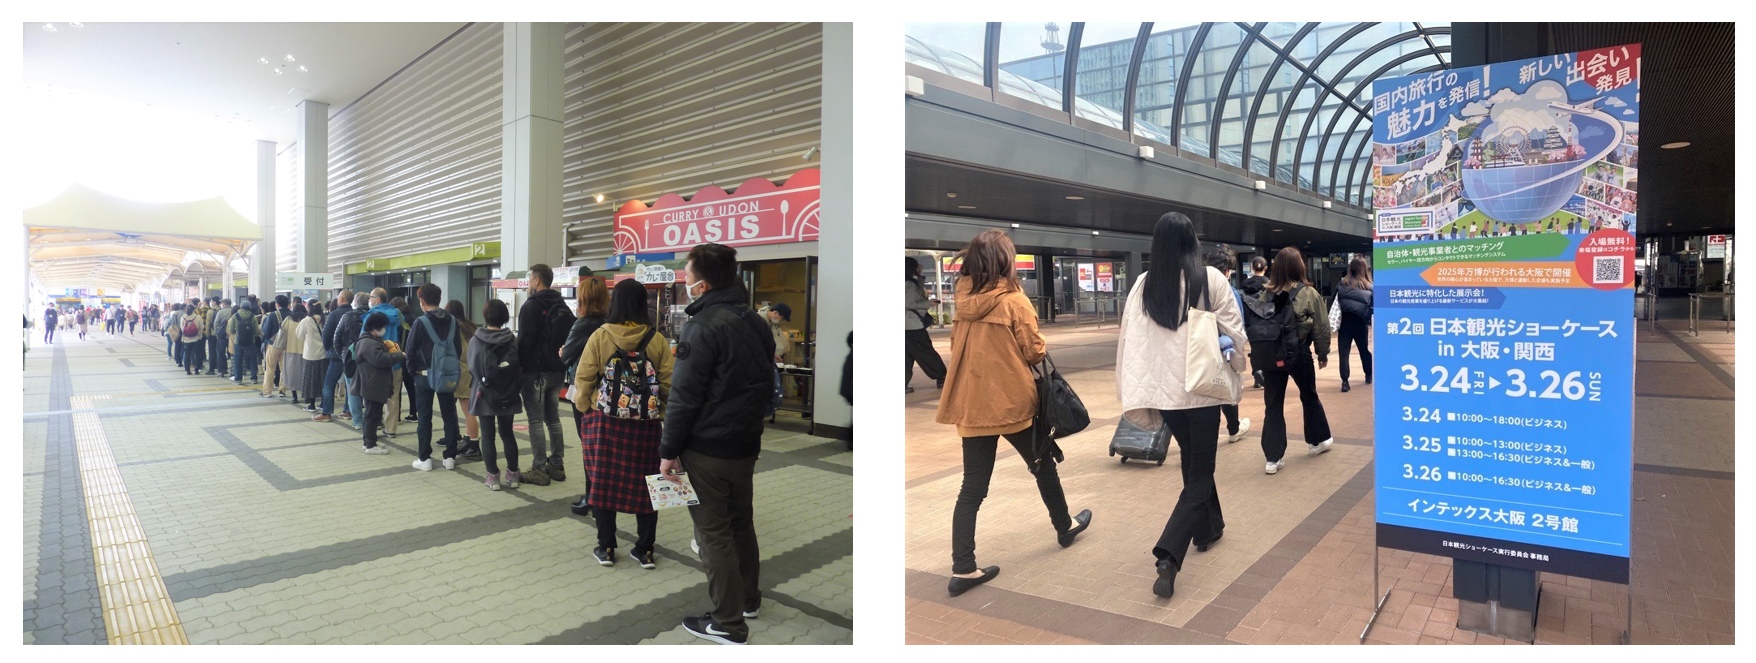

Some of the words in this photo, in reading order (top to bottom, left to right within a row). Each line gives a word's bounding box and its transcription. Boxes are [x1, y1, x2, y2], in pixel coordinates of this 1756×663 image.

[1519, 53, 1571, 85] 新しい
[1566, 46, 1630, 87] 出会い
[1373, 69, 1458, 116] 国内旅行の
[663, 209, 699, 224] CURRY
[719, 201, 759, 217] UDON
[663, 215, 760, 245] OASIS
[475, 244, 485, 255] 2
[1386, 241, 1505, 259] 自治体・観光事業者とのマッチング
[1589, 236, 1630, 246] 入場無料!
[304, 276, 325, 286] 受付
[646, 271, 674, 283] カレー屋台
[1437, 267, 1572, 278] 2025年万博が行われる大阪で開催
[1389, 288, 1485, 298] 日本観光に特化した展示会!
[1387, 317, 1425, 335] 第2回
[1430, 318, 1618, 338] 日本観光ショーケース
[1438, 340, 1455, 357] in
[1461, 341, 1555, 362] 大阪・関西
[1400, 365, 1472, 394] 3.24
[1473, 371, 1485, 396] FRI
[1505, 368, 1586, 402] 3.26
[1588, 372, 1602, 402] SUN
[1402, 406, 1441, 424] 3.24
[1402, 435, 1442, 453] 3.25
[1402, 463, 1442, 482] 3.26
[1408, 498, 1526, 527] インテックス大阪
[1531, 513, 1579, 534] 2号館
[1442, 540, 1529, 559] 日本観光ショーケース実行委員会
